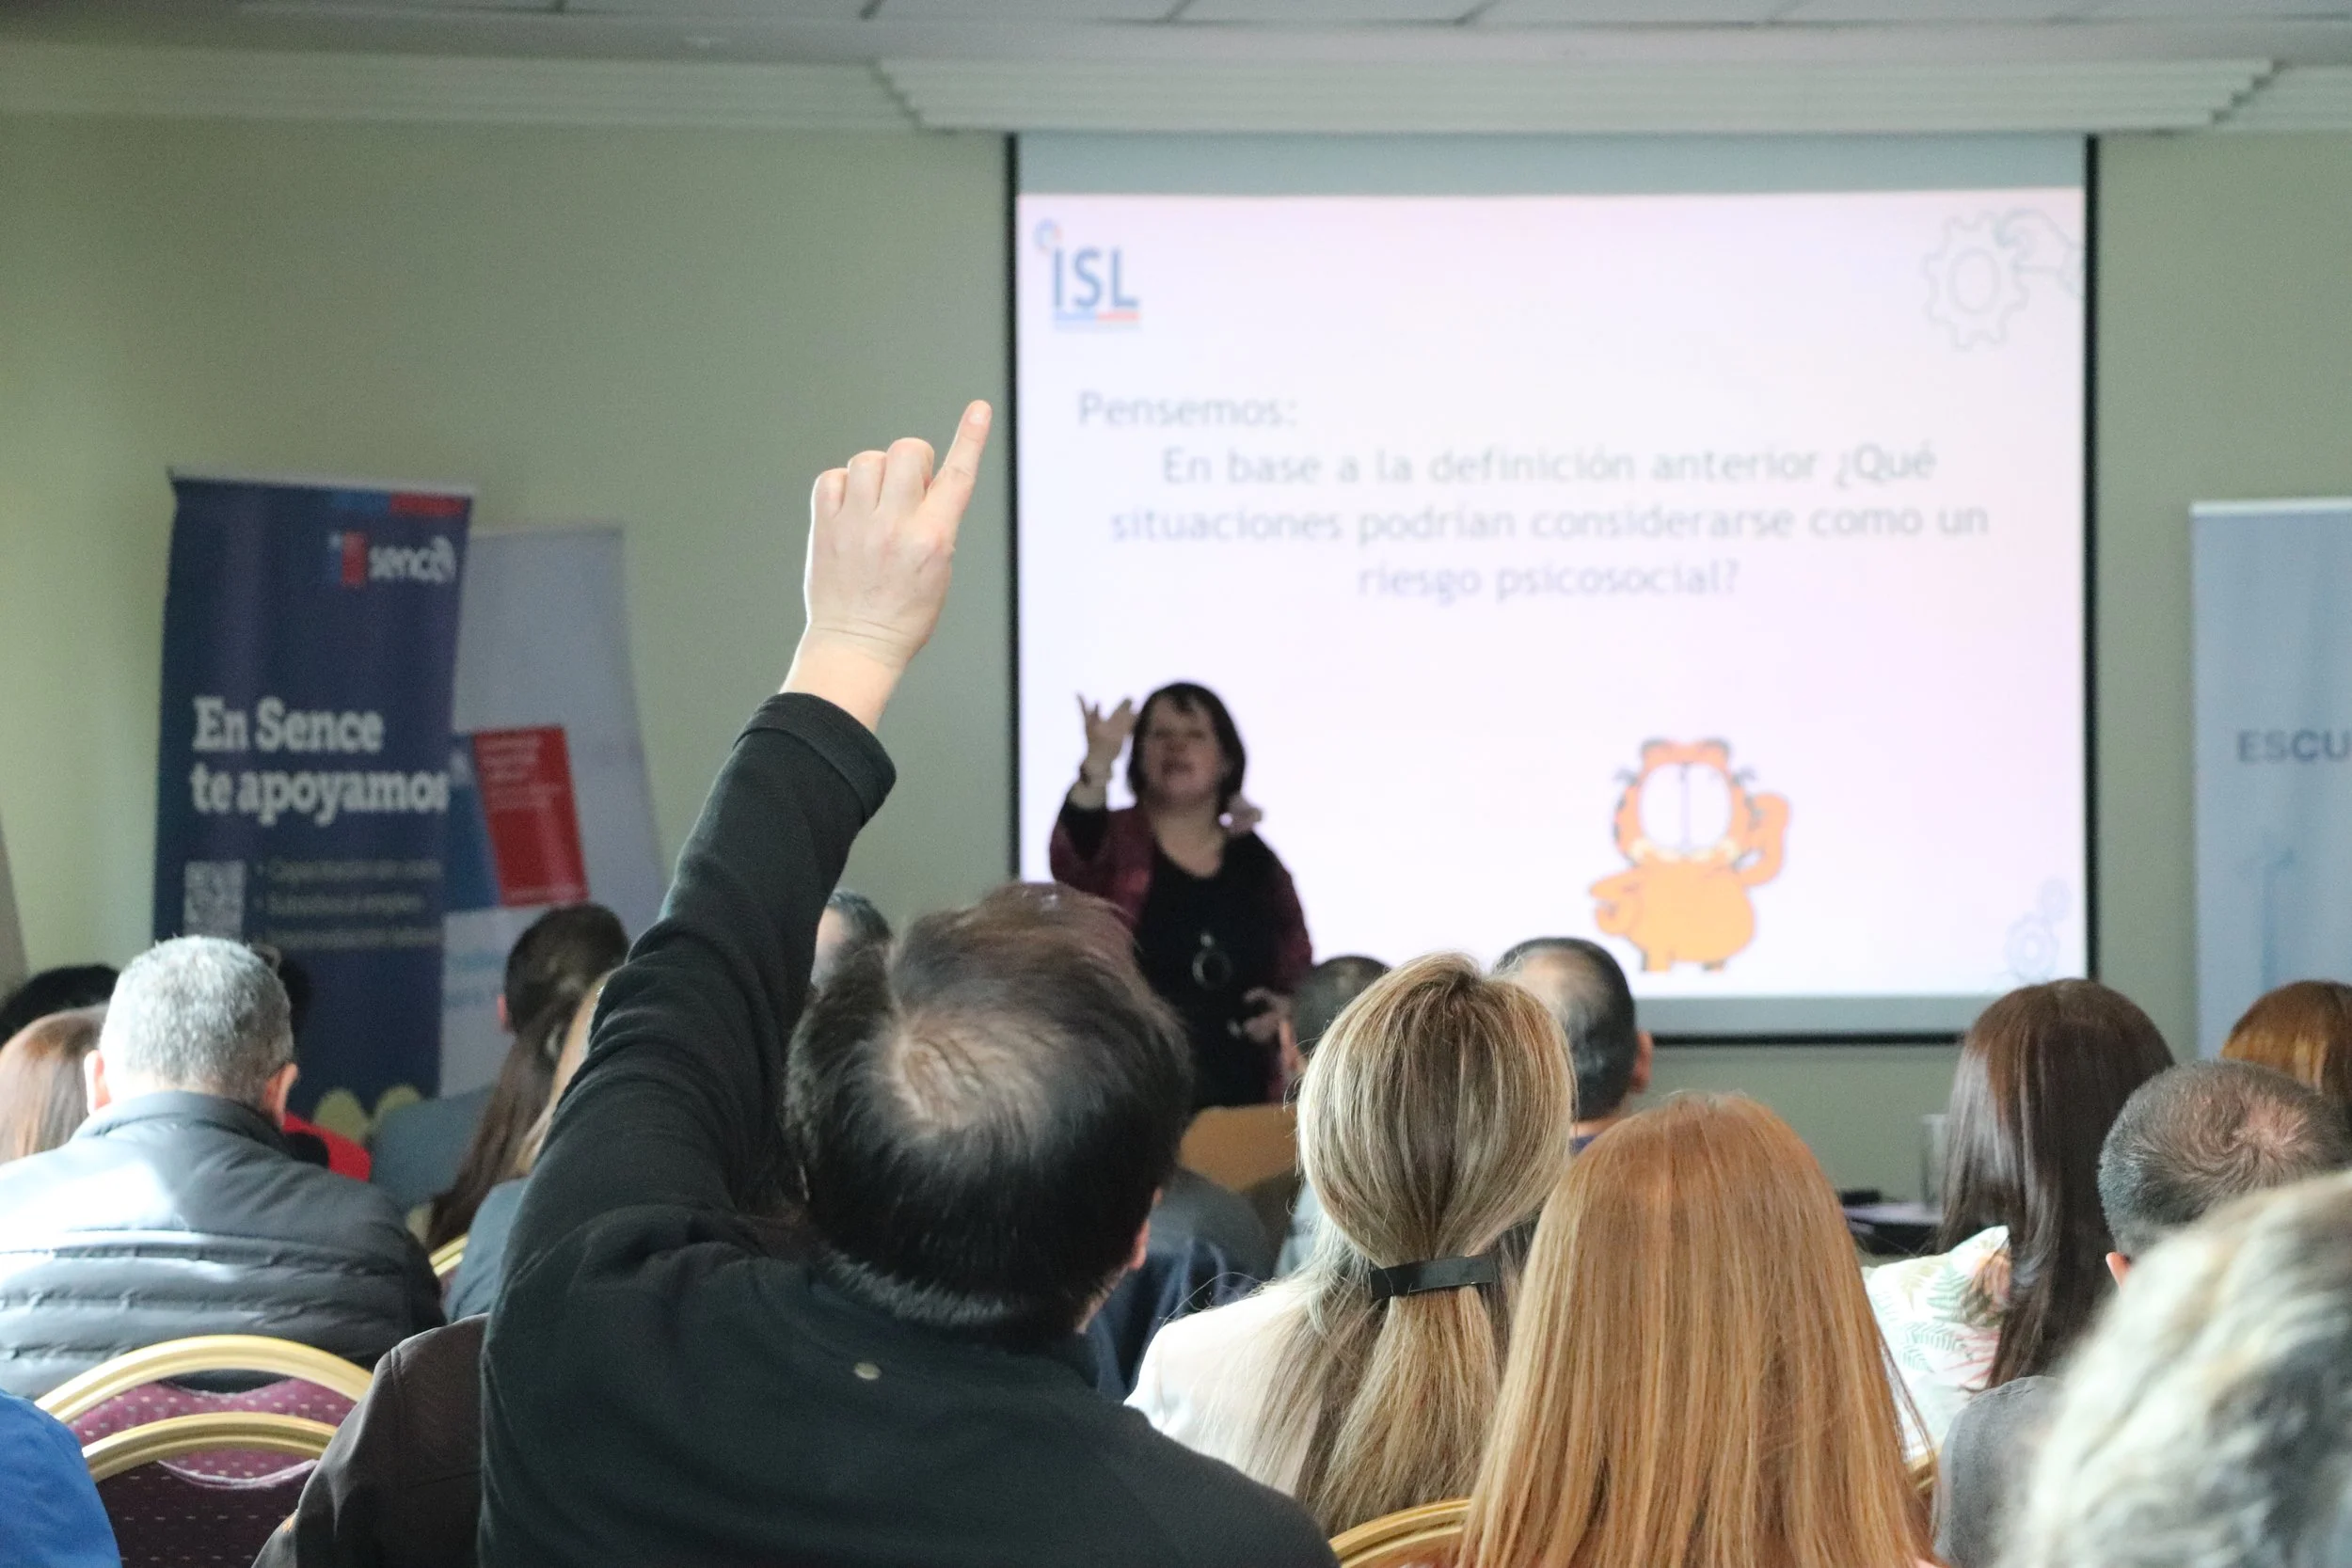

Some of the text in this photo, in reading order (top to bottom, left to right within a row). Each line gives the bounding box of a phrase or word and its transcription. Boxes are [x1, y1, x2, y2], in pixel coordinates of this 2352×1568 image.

[1051, 245, 1140, 309] ISL
[1077, 390, 1299, 428] Pensemos:
[1161, 437, 1938, 490] En base a la definición anterior ¿Qué
[1109, 499, 1991, 546] situaciones podrían considerarse como un
[1357, 557, 1740, 607] riesgo psicosocial?
[191, 694, 386, 752] En Sence
[189, 760, 233, 815] te
